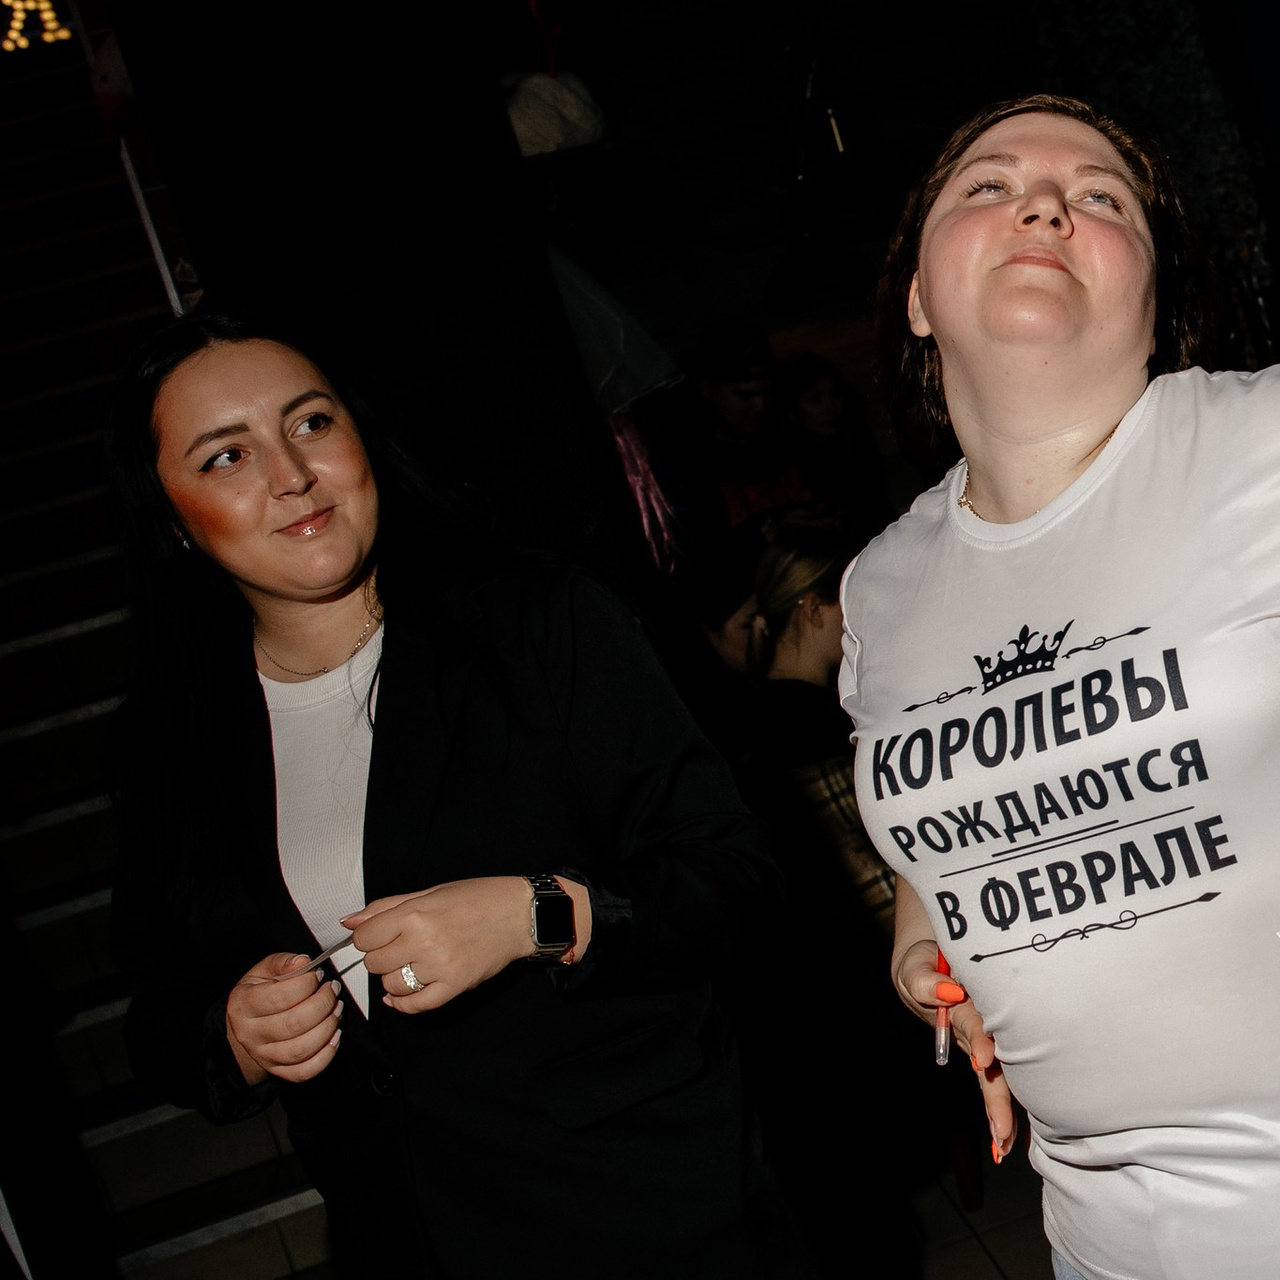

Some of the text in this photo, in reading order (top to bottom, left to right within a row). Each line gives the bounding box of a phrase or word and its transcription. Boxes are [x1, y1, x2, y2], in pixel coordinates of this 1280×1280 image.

[872, 647, 1190, 802] КОРОЛЕВЫ
[888, 738, 1210, 863] РОЖДАЮТСЯ
[935, 814, 1239, 942] В ФЕВРАЛЕ
